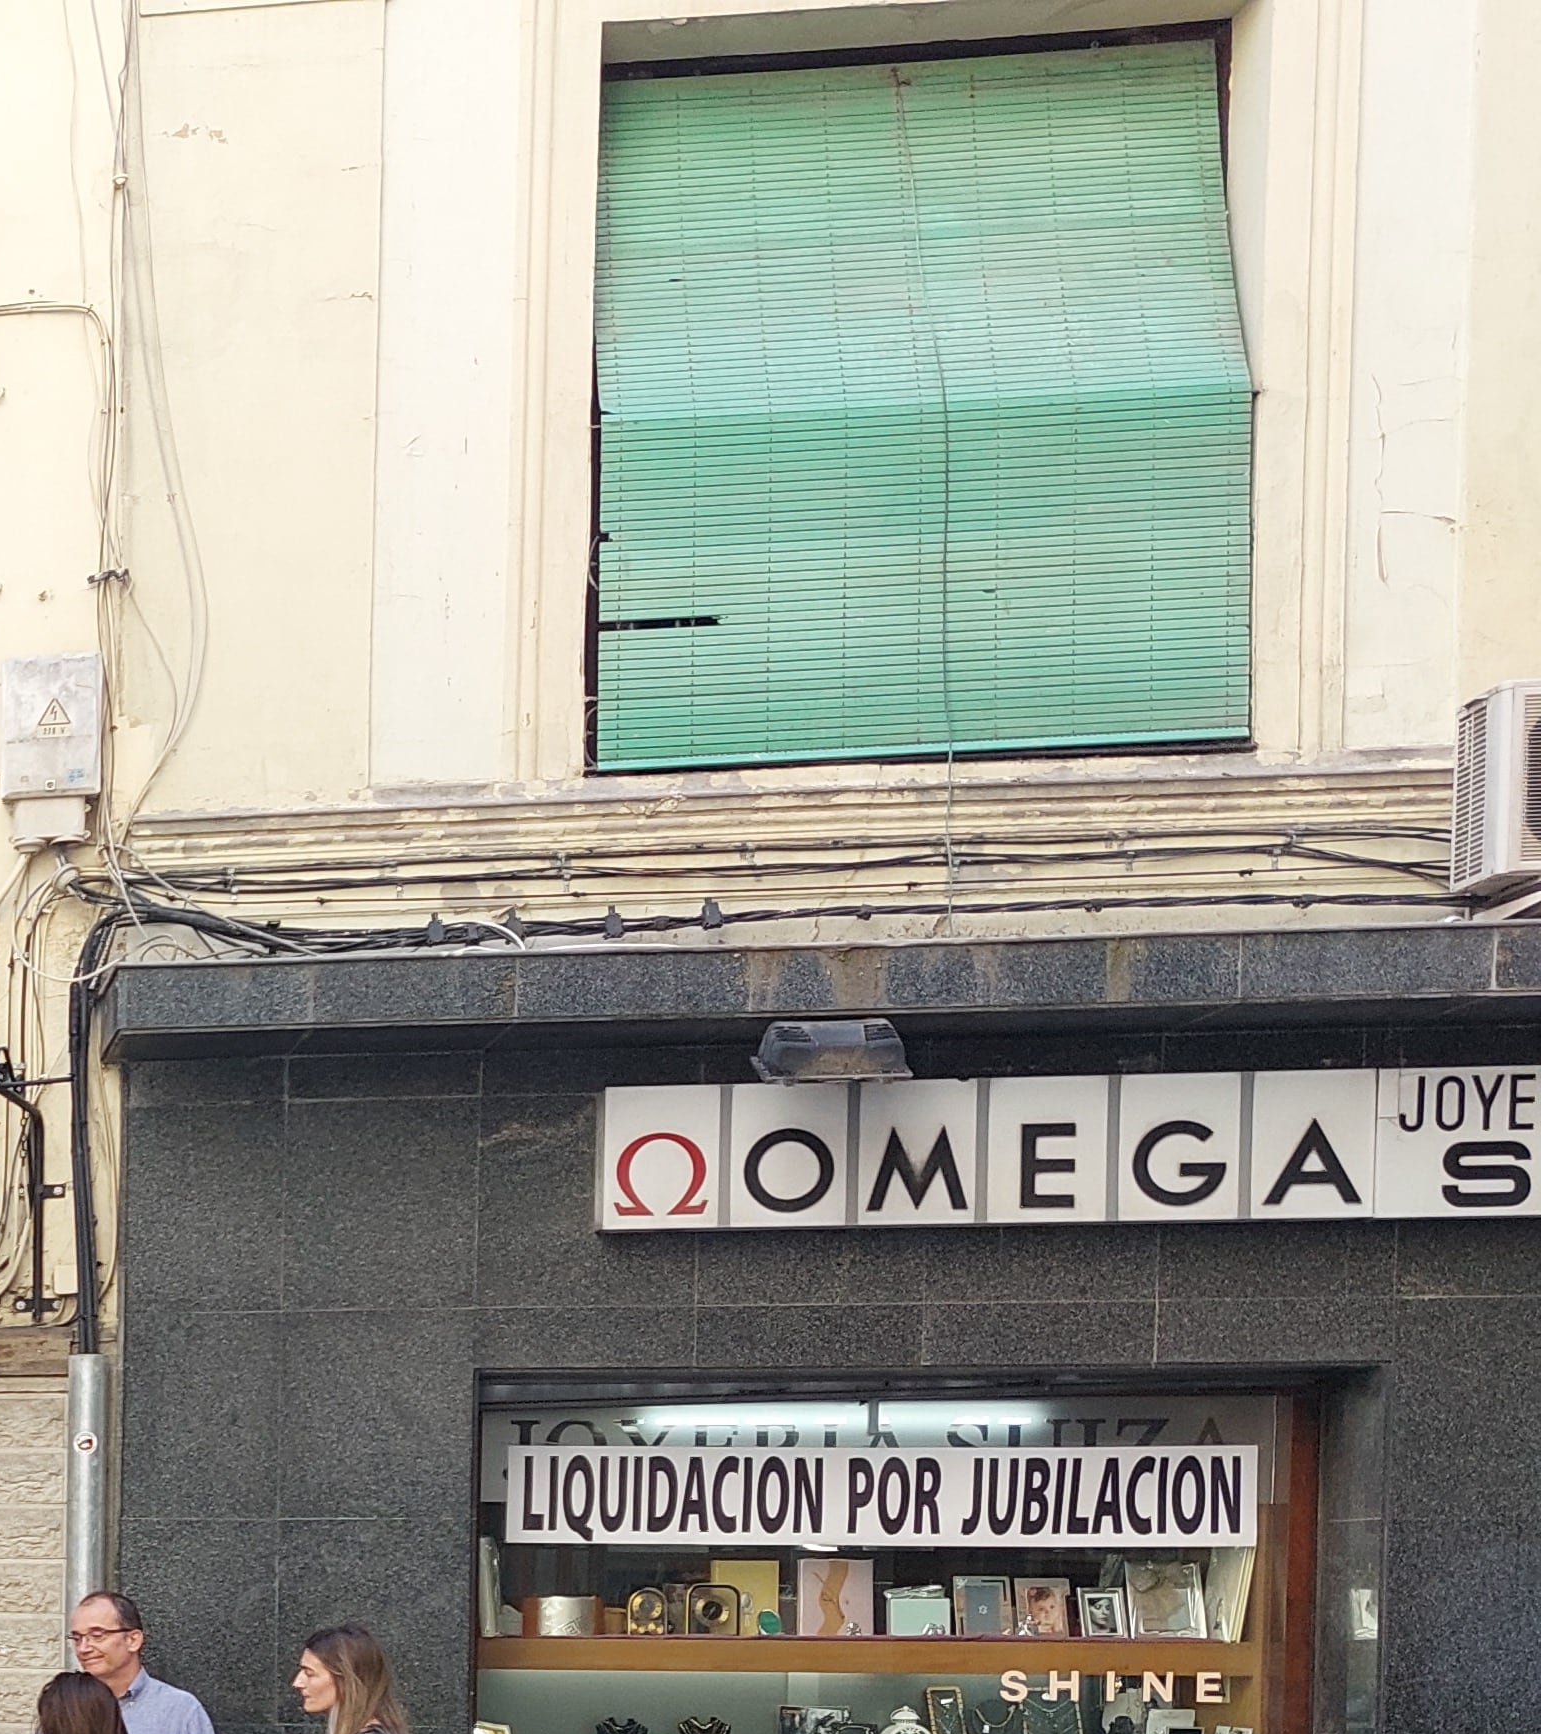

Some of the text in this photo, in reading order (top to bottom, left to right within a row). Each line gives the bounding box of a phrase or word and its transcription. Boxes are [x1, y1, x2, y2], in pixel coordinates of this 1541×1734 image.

[1398, 1073, 1536, 1132] JOYE
[743, 1117, 1363, 1213] OMEGA
[1441, 1141, 1532, 1208] S
[521, 1454, 1242, 1541] LIQUIDACION POR JUBILACION
[999, 1670, 1225, 1704] SHINE
